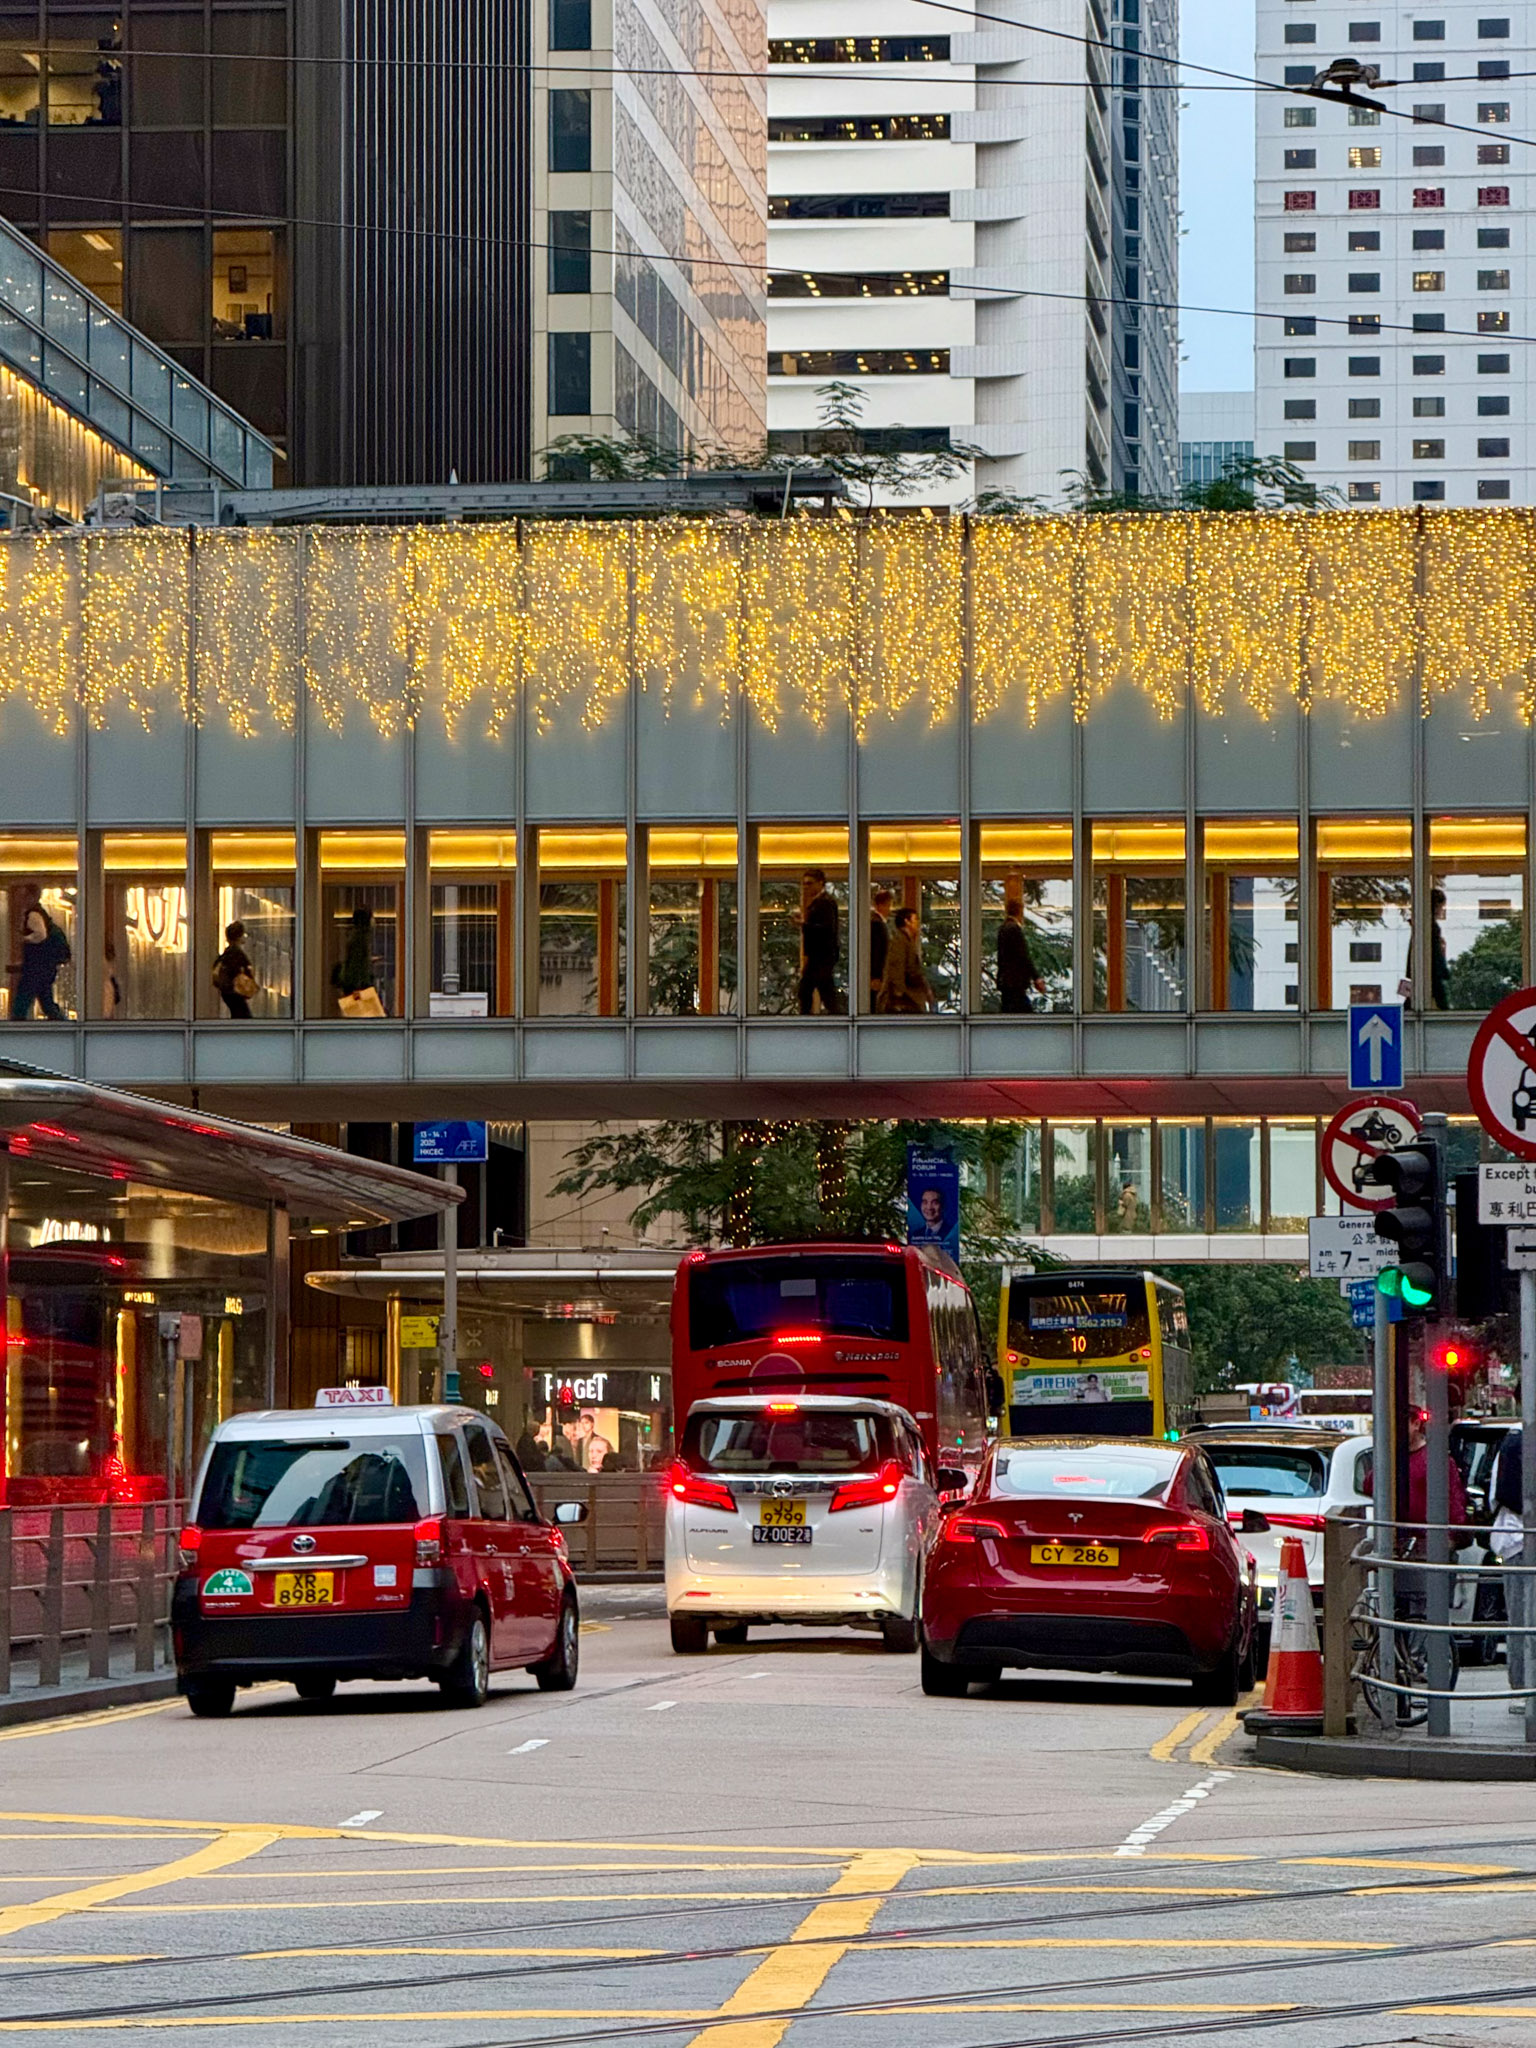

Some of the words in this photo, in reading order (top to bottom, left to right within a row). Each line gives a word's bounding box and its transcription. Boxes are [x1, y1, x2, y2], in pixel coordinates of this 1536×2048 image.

[420, 1139, 436, 1147] 2025
[420, 1148, 444, 1156] HKCEC
[1485, 1168, 1531, 1181] Except
[1315, 1261, 1337, 1272] 上午
[1340, 1251, 1352, 1270] 7
[1071, 1336, 1087, 1352] 10
[845, 1352, 899, 1361] Marcopolo
[717, 1359, 751, 1367] SCANIA
[324, 1389, 384, 1403] TAXI
[773, 1501, 793, 1512] JJ
[764, 1512, 803, 1524] 9799
[1041, 1548, 1064, 1561] CY
[1073, 1549, 1109, 1563] 286
[223, 1577, 233, 1586] 4
[293, 1574, 316, 1589] XR
[280, 1588, 329, 1604] 8982
